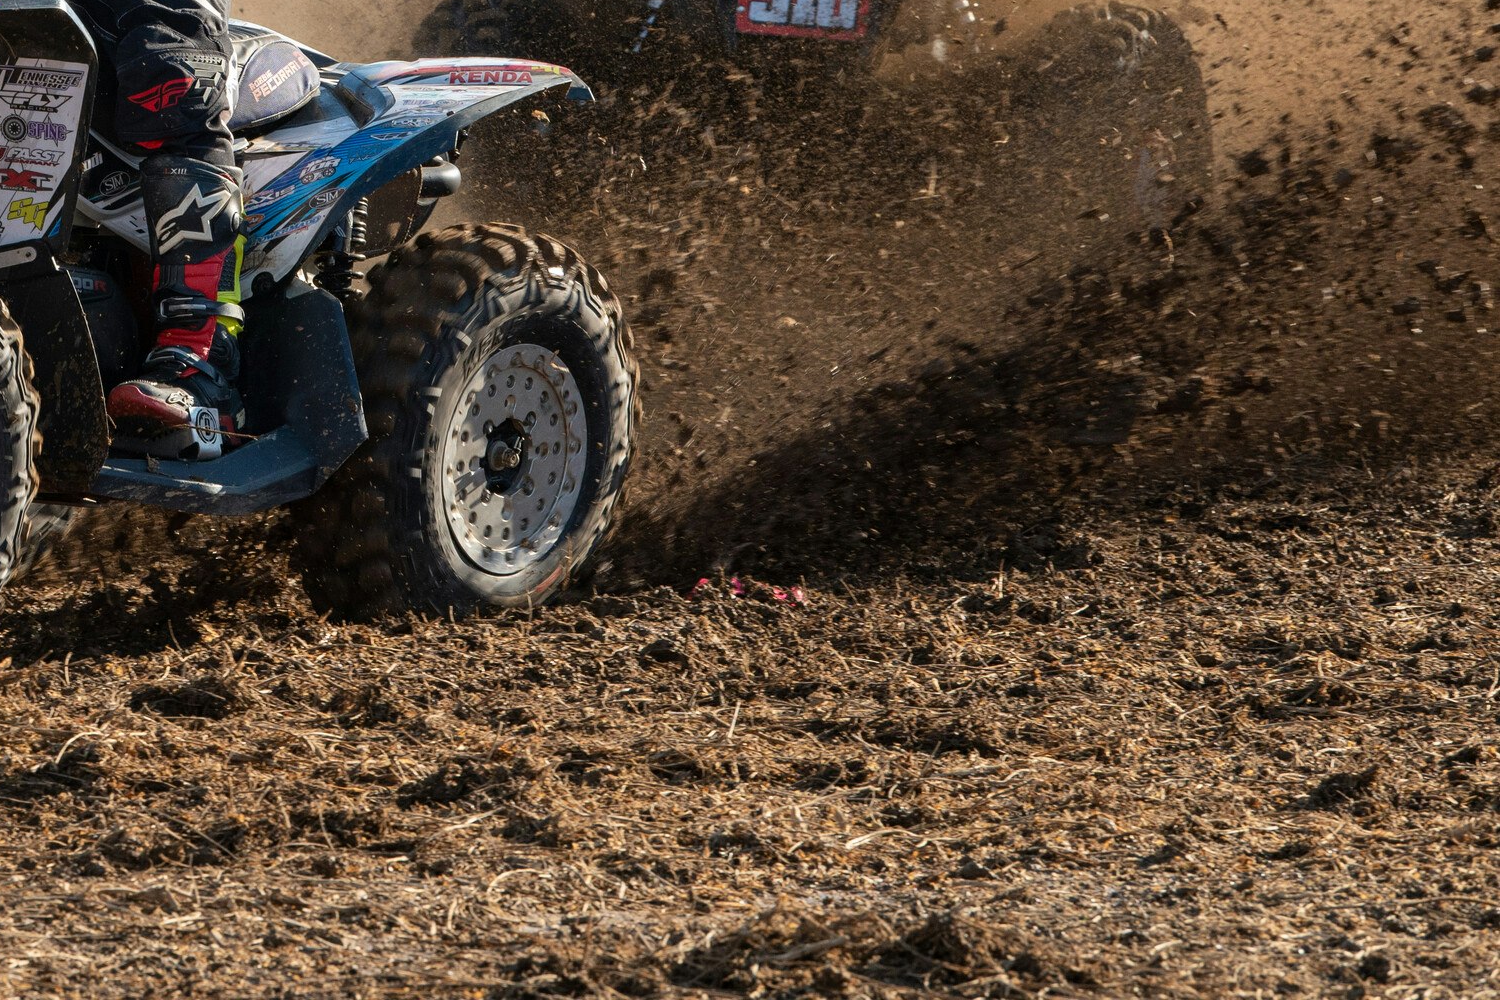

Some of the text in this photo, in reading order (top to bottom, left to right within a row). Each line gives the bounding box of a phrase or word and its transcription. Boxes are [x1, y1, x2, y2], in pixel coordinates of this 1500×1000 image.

[252, 63, 301, 102] PECORARI
[449, 71, 534, 86] KENDA
[6, 146, 66, 162] FASST
